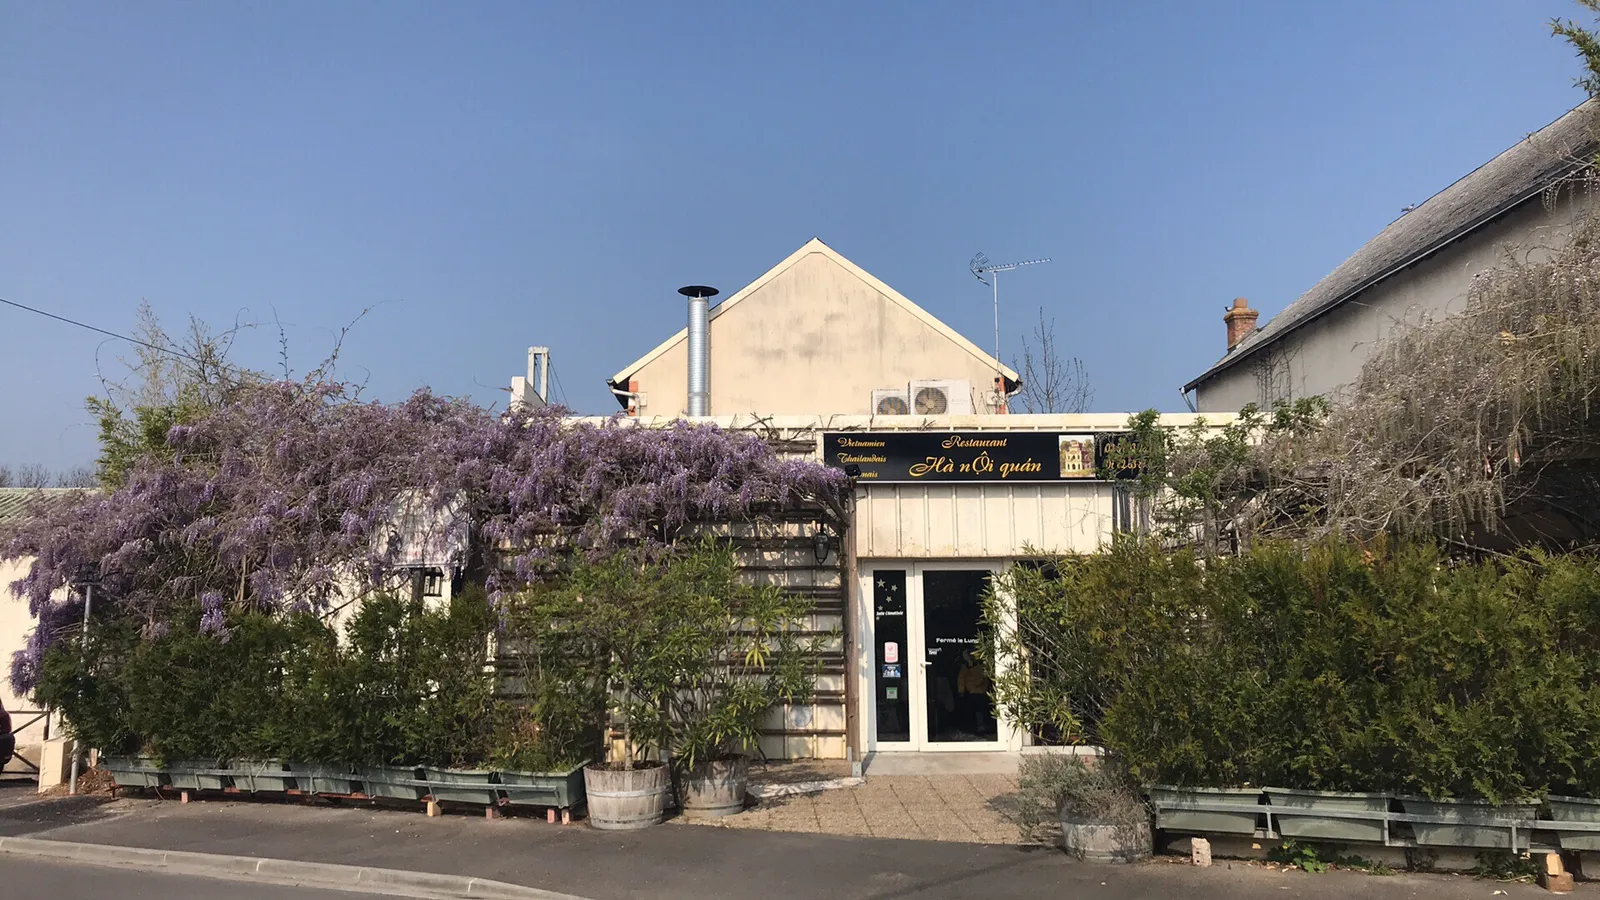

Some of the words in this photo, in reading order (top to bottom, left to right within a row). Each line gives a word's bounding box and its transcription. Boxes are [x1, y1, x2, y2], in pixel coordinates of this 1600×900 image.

[837, 437, 886, 448] Vietnamien
[941, 435, 1008, 449] Restaurant
[908, 456, 955, 477] Hà
[999, 457, 1042, 478] quán
